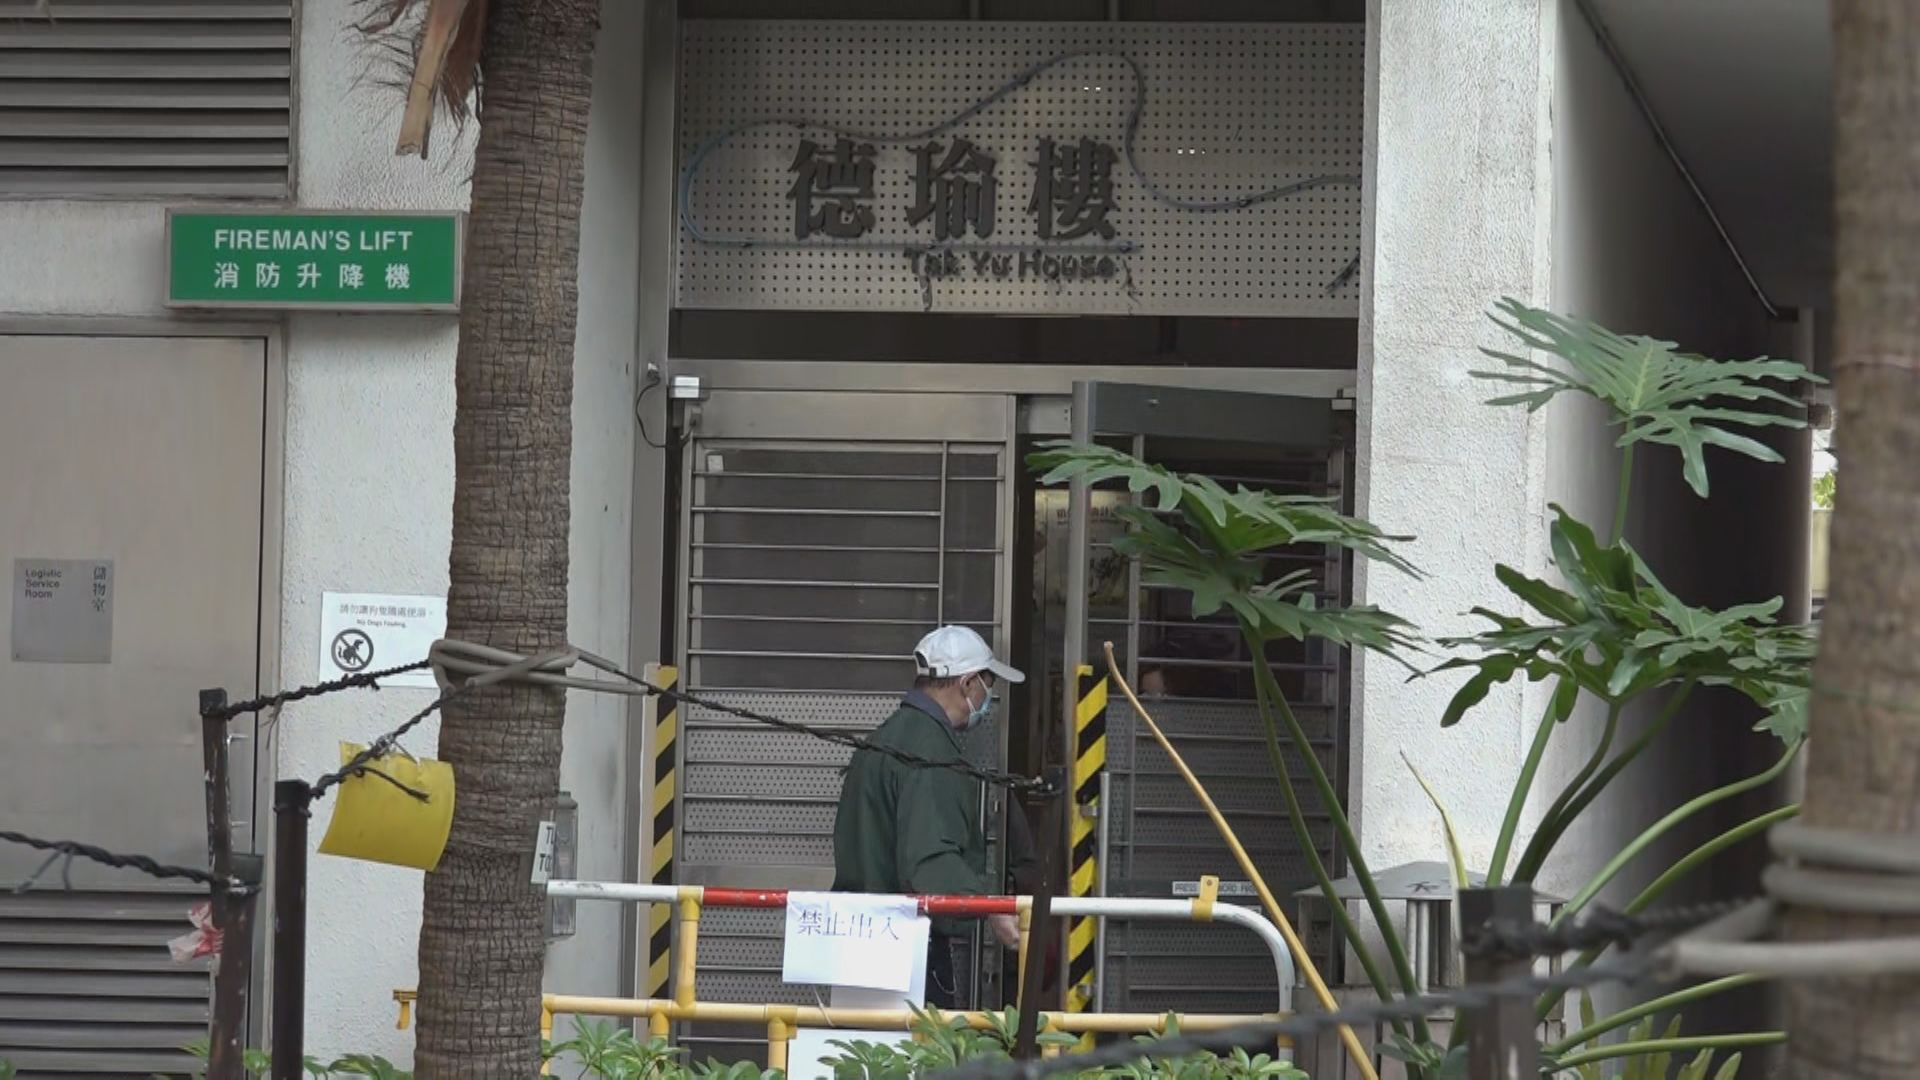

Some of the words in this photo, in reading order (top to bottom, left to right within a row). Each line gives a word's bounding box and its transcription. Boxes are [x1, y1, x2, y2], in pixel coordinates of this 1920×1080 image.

[786, 134, 1120, 241] 德瑜樓
[214, 229, 350, 250] FIREMAN'S
[360, 231, 413, 250] LIFT
[214, 262, 410, 289] 消防升降機
[903, 248, 960, 278] Tak
[969, 250, 1012, 277] Yu
[1018, 249, 1115, 279] House
[25, 569, 62, 579] Logistic
[25, 579, 60, 588] Service
[25, 589, 53, 598] Room
[797, 909, 899, 941] 禁止出入
